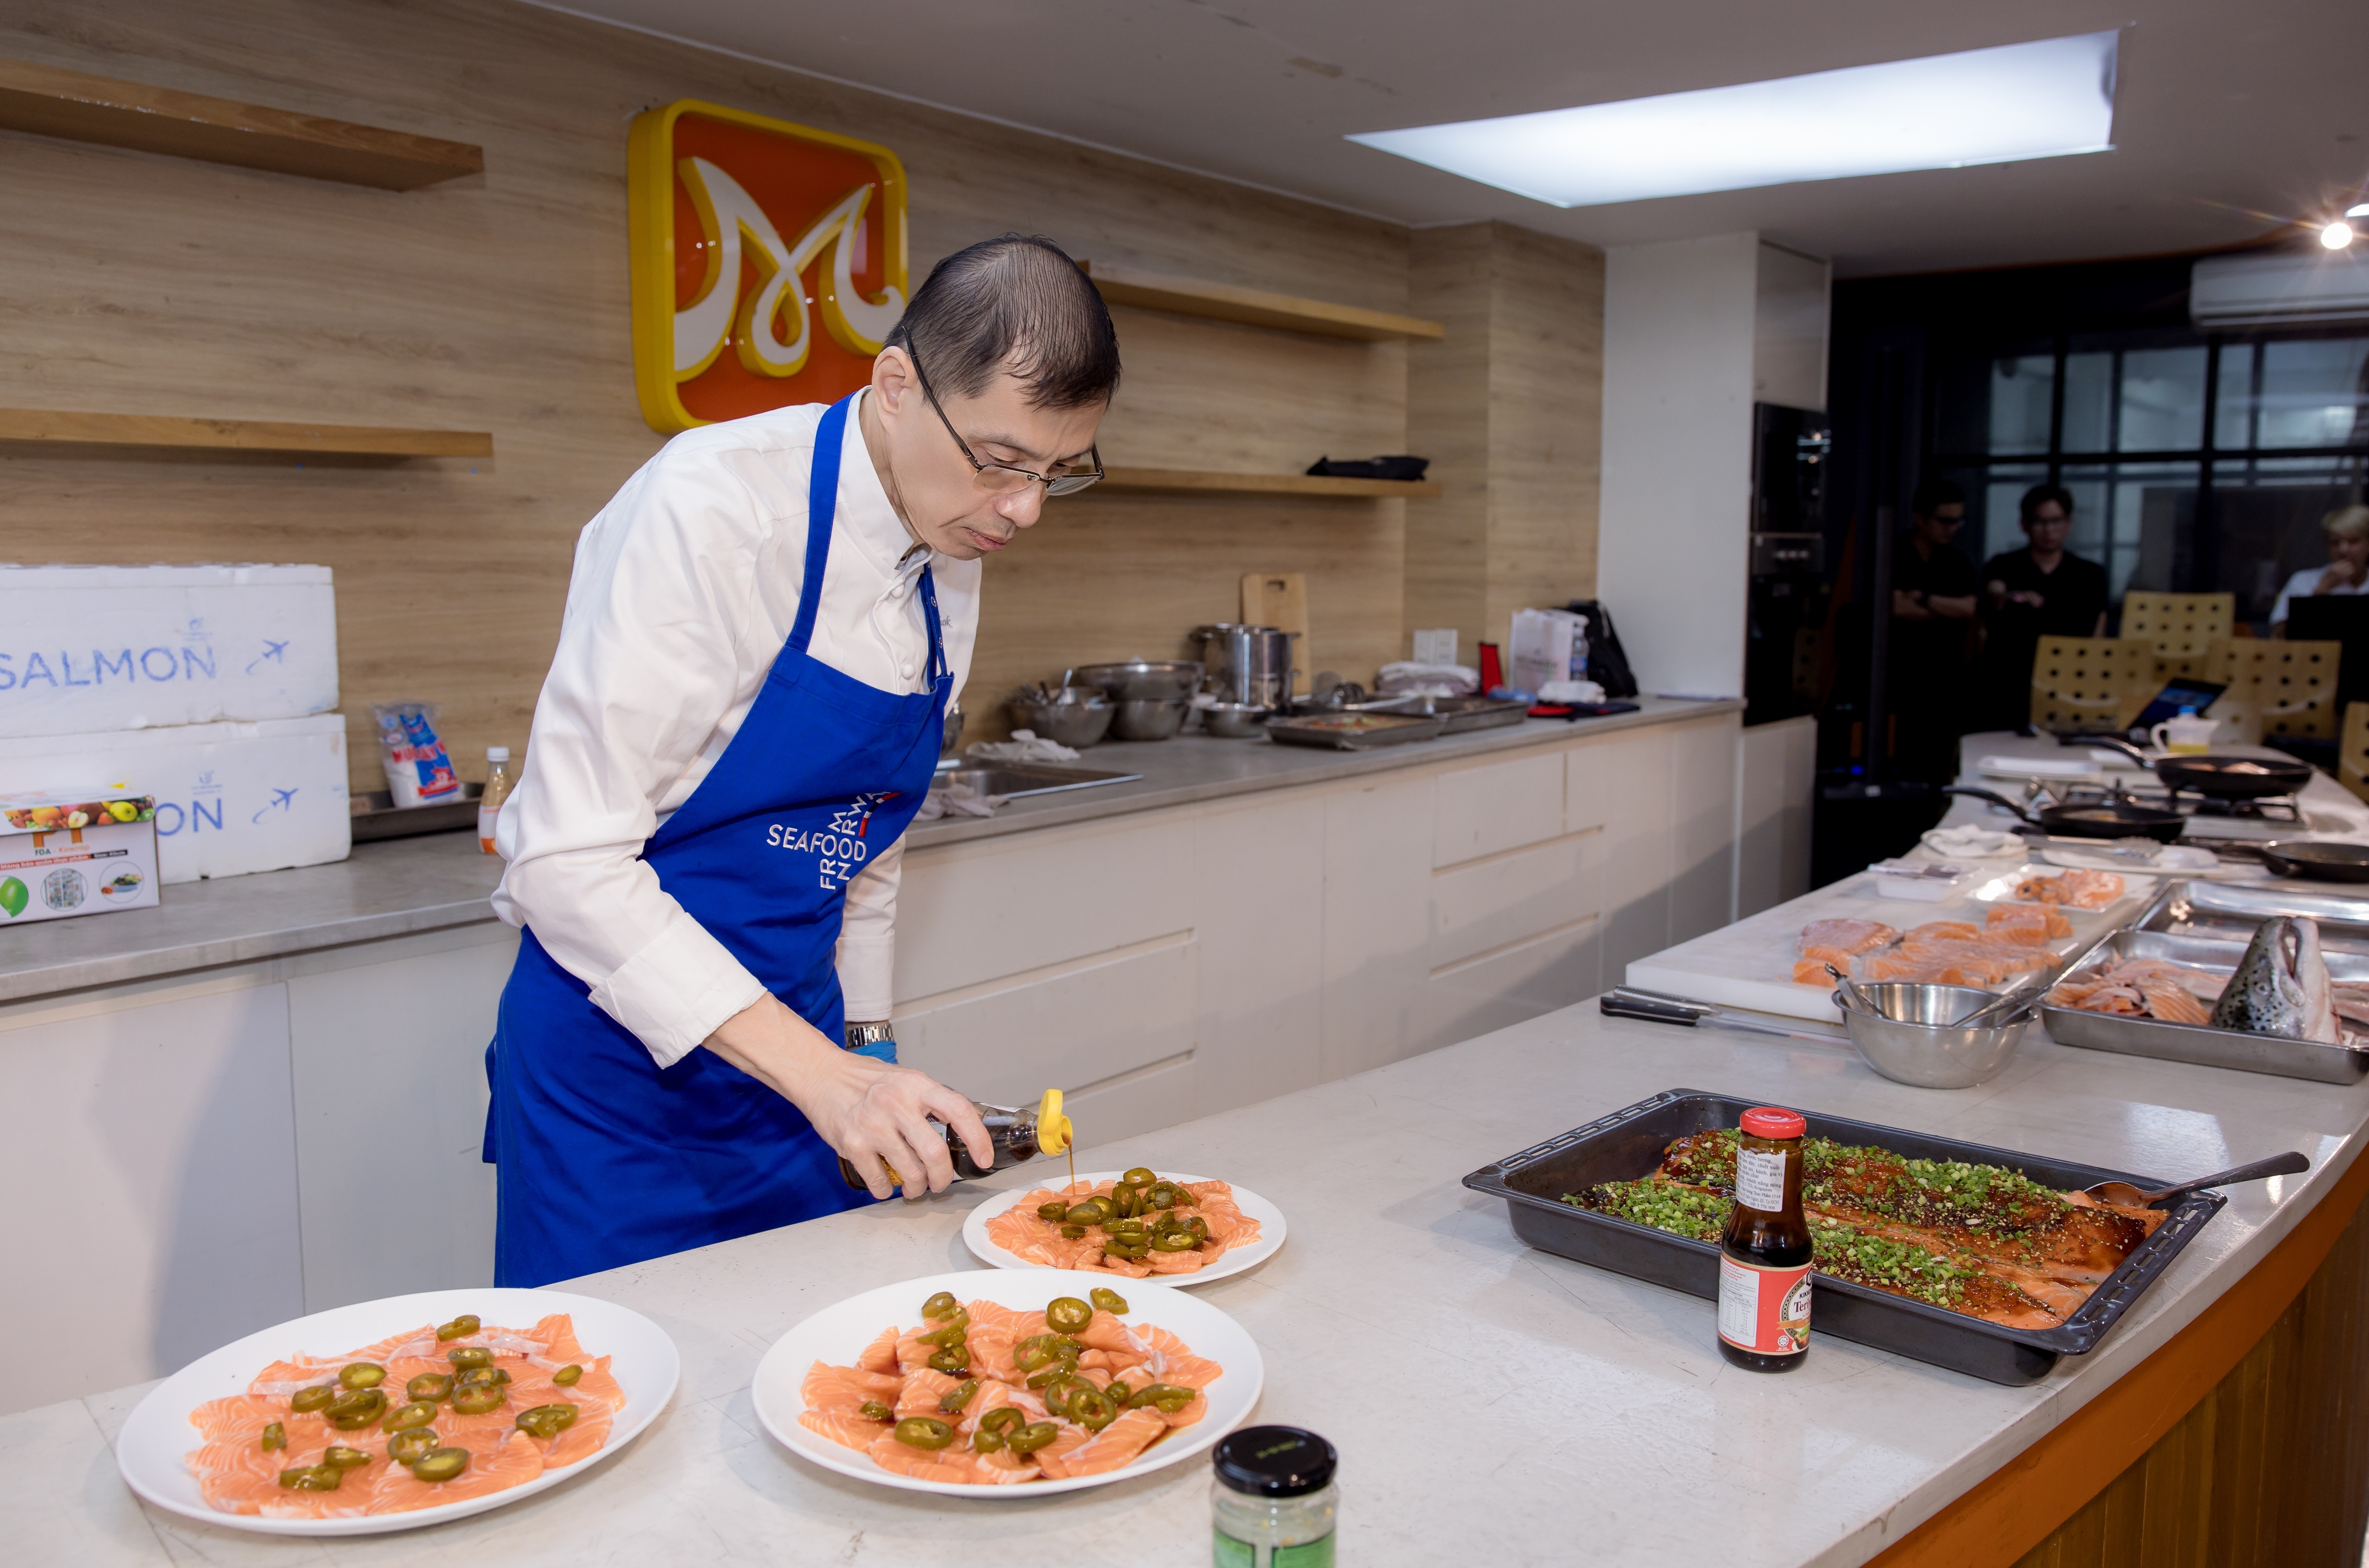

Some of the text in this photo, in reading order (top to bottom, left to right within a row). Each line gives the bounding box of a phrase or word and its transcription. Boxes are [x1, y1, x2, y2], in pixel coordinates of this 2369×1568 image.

[0, 646, 216, 690] SALMON
[766, 823, 867, 862] SEAFOOD
[837, 791, 891, 881] NORWA
